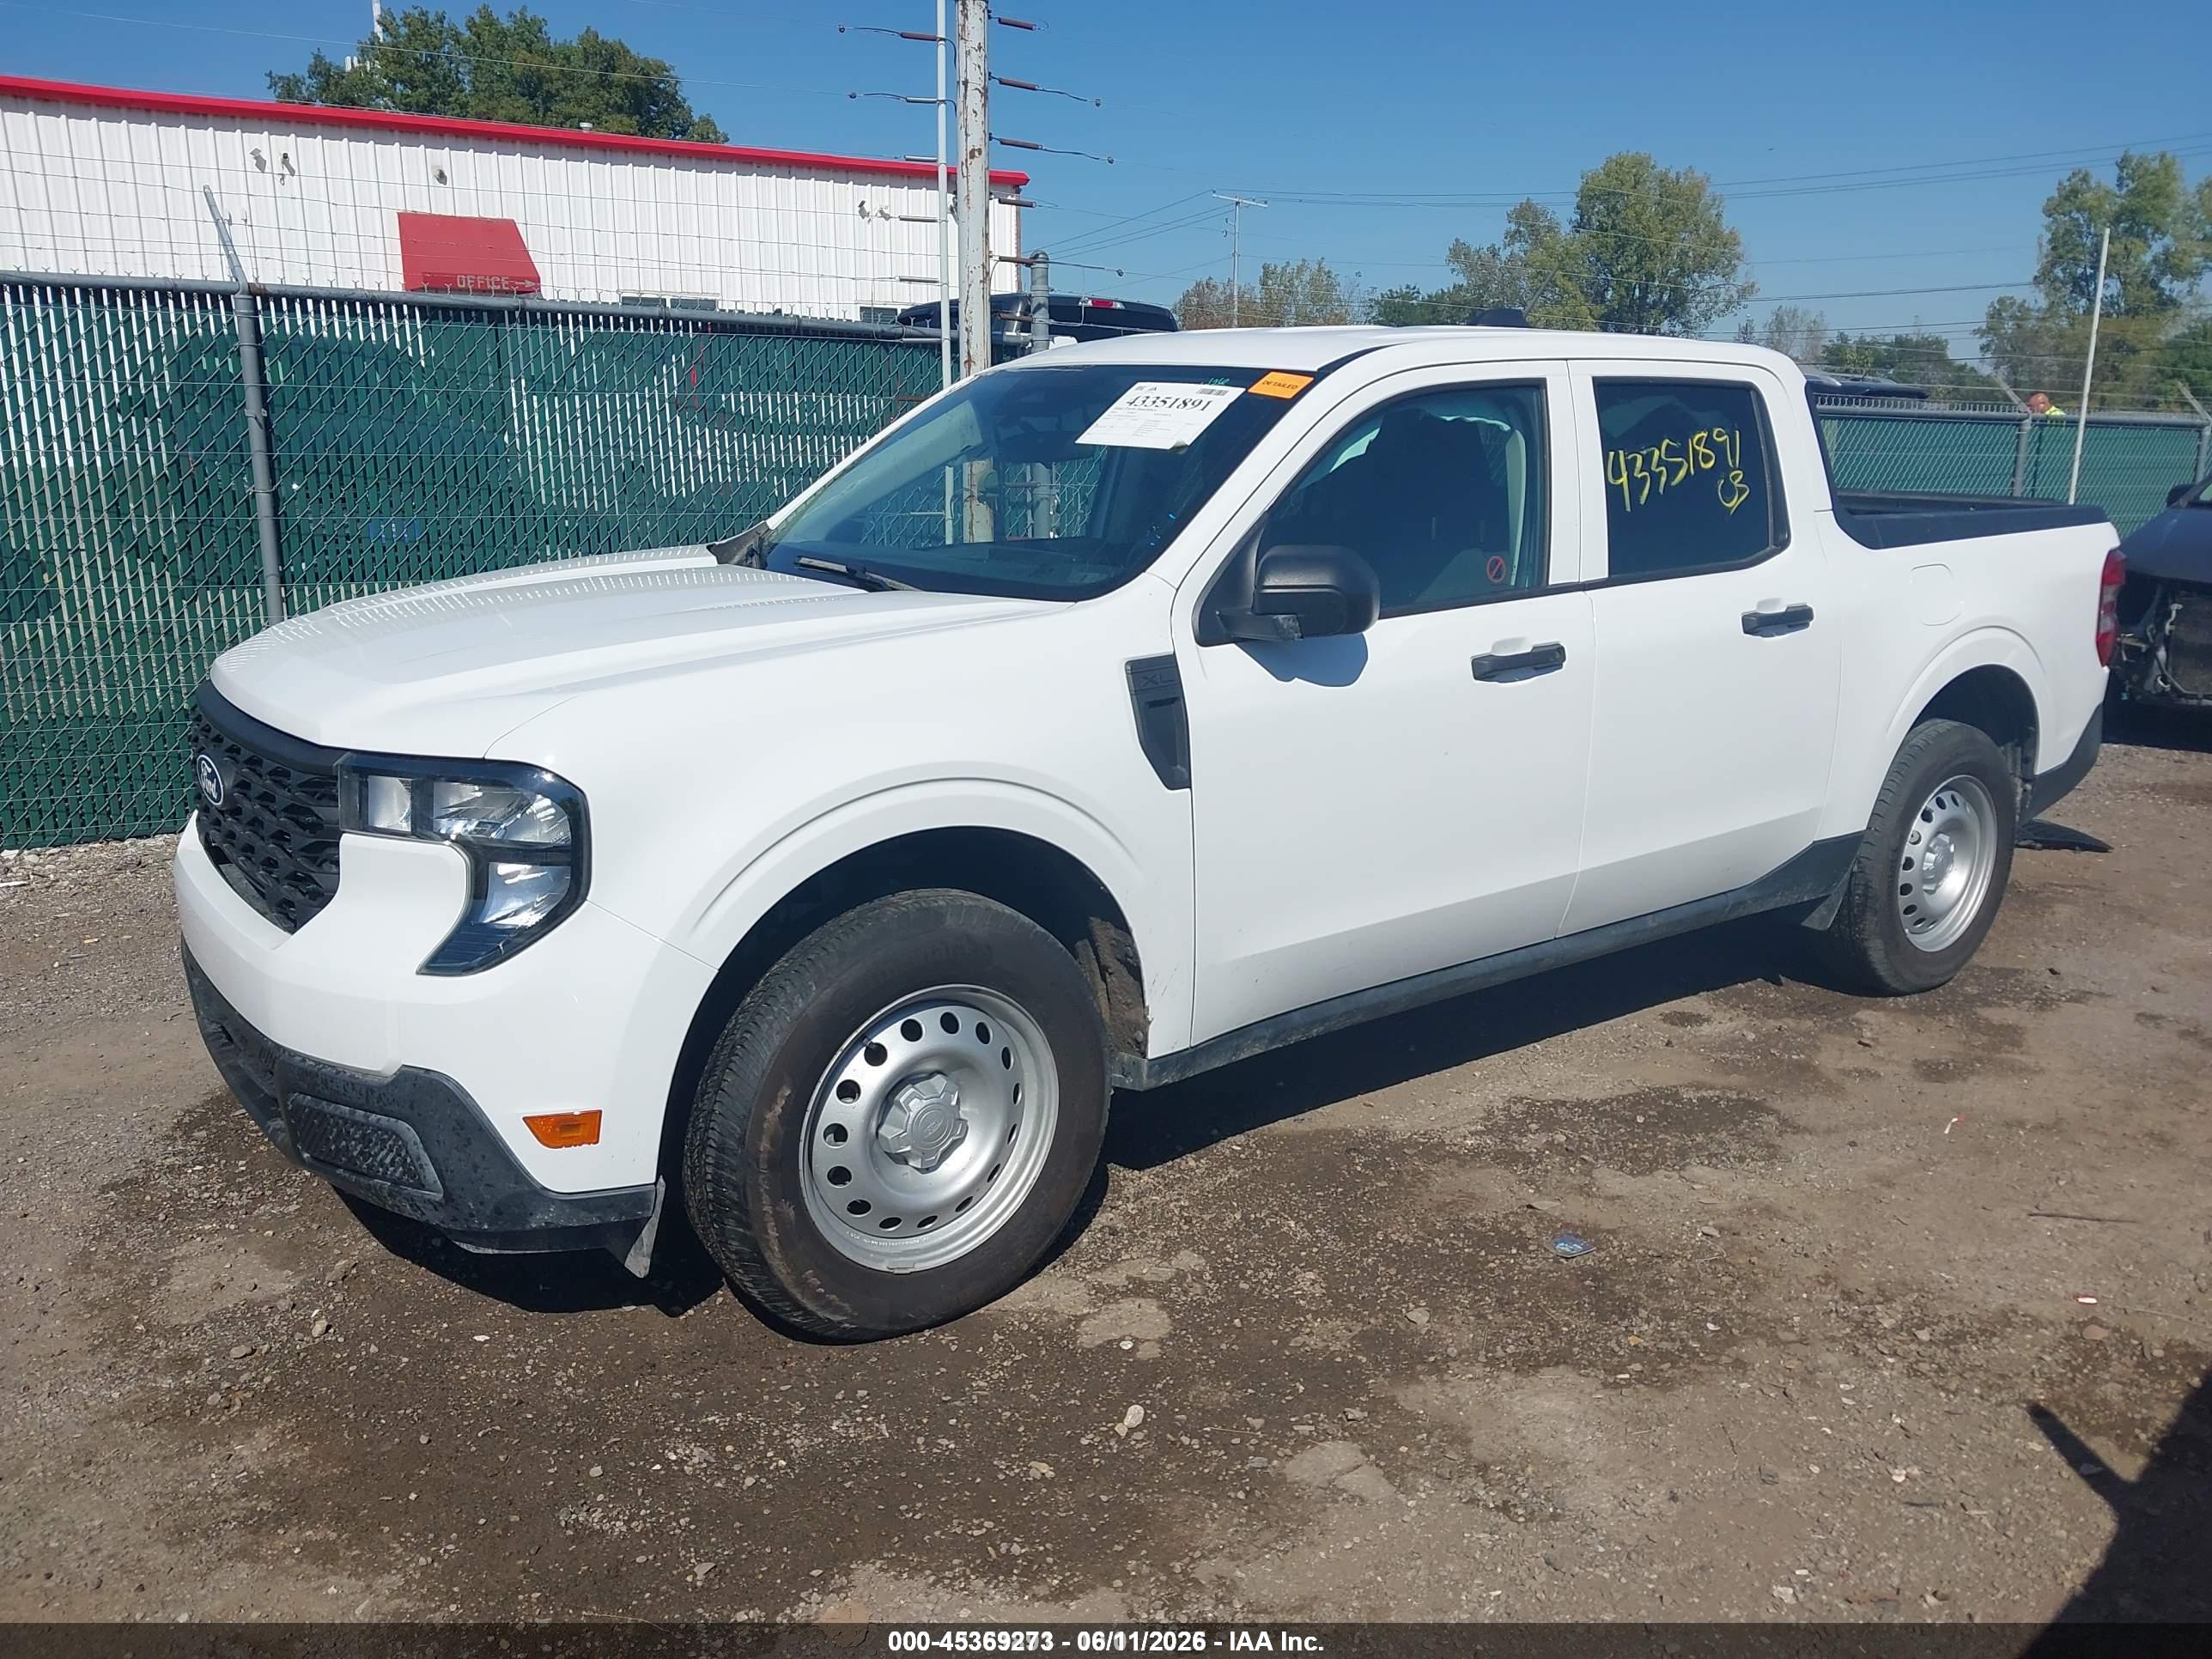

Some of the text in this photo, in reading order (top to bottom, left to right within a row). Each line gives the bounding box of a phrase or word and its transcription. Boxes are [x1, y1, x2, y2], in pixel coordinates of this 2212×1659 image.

[457, 275, 510, 290] OFFICE
[1127, 395, 1212, 411] 43351891
[1607, 428, 1741, 513] 43351891
[199, 759, 220, 800] Ford
